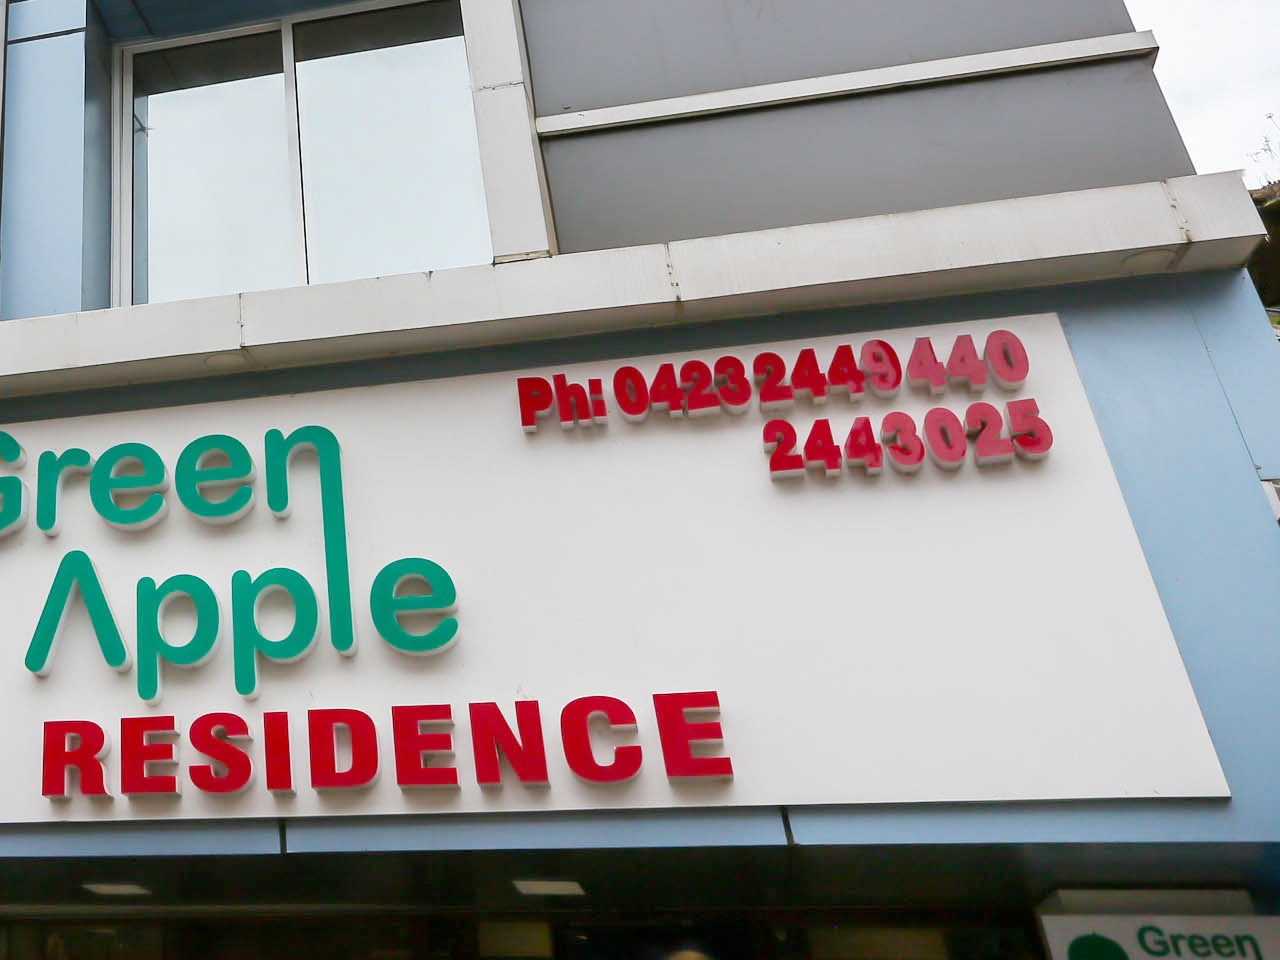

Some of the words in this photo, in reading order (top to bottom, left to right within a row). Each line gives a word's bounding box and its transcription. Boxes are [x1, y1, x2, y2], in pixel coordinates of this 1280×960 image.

[762, 398, 1054, 483] 2443025
[24, 549, 461, 704] Apple
[41, 690, 734, 800] RESIDENCE
[1136, 925, 1263, 960] Green
